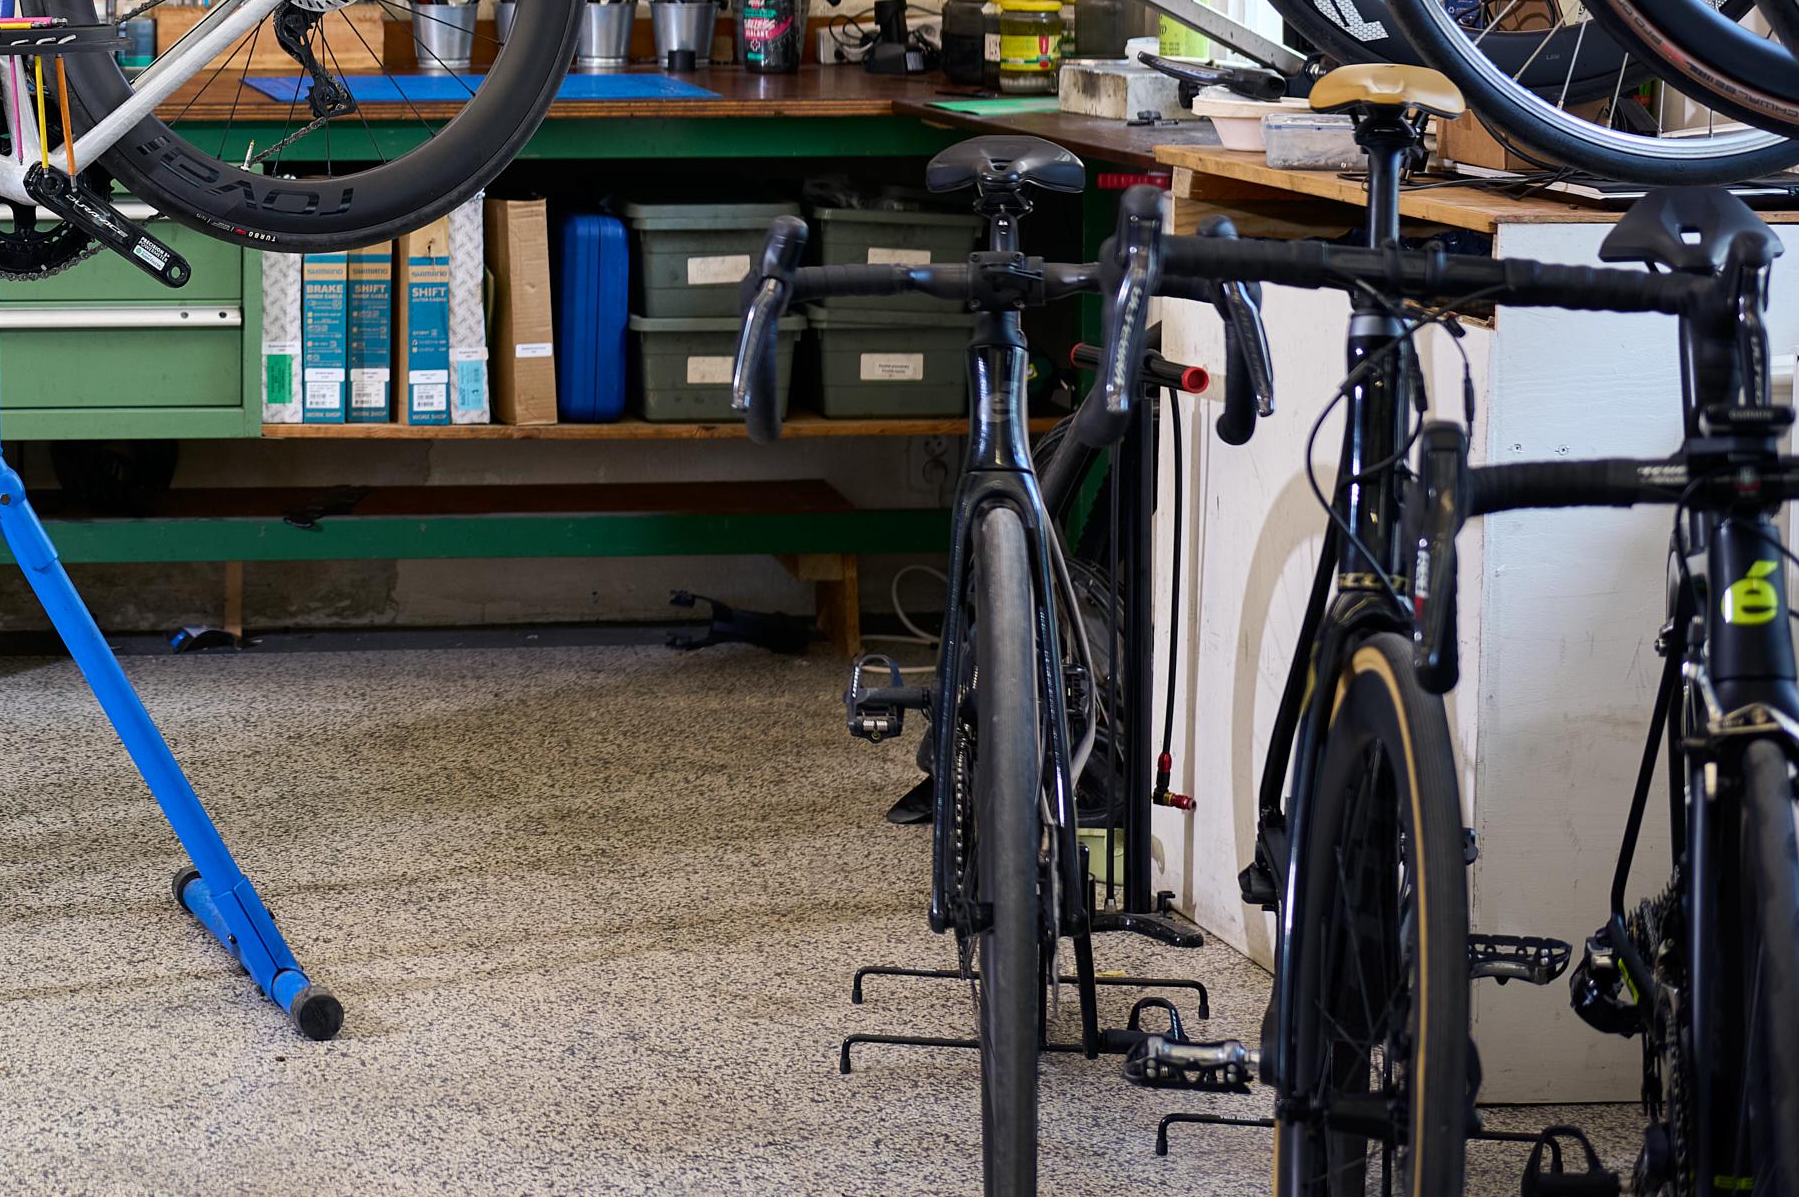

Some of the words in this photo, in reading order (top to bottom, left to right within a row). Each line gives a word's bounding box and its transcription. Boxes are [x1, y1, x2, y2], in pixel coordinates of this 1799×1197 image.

[66, 194, 129, 238] DURA-ACE
[248, 231, 277, 243] TURBO
[307, 284, 343, 293] BRAKE
[354, 284, 387, 293] SHIFT
[412, 287, 447, 297] SHIFT
